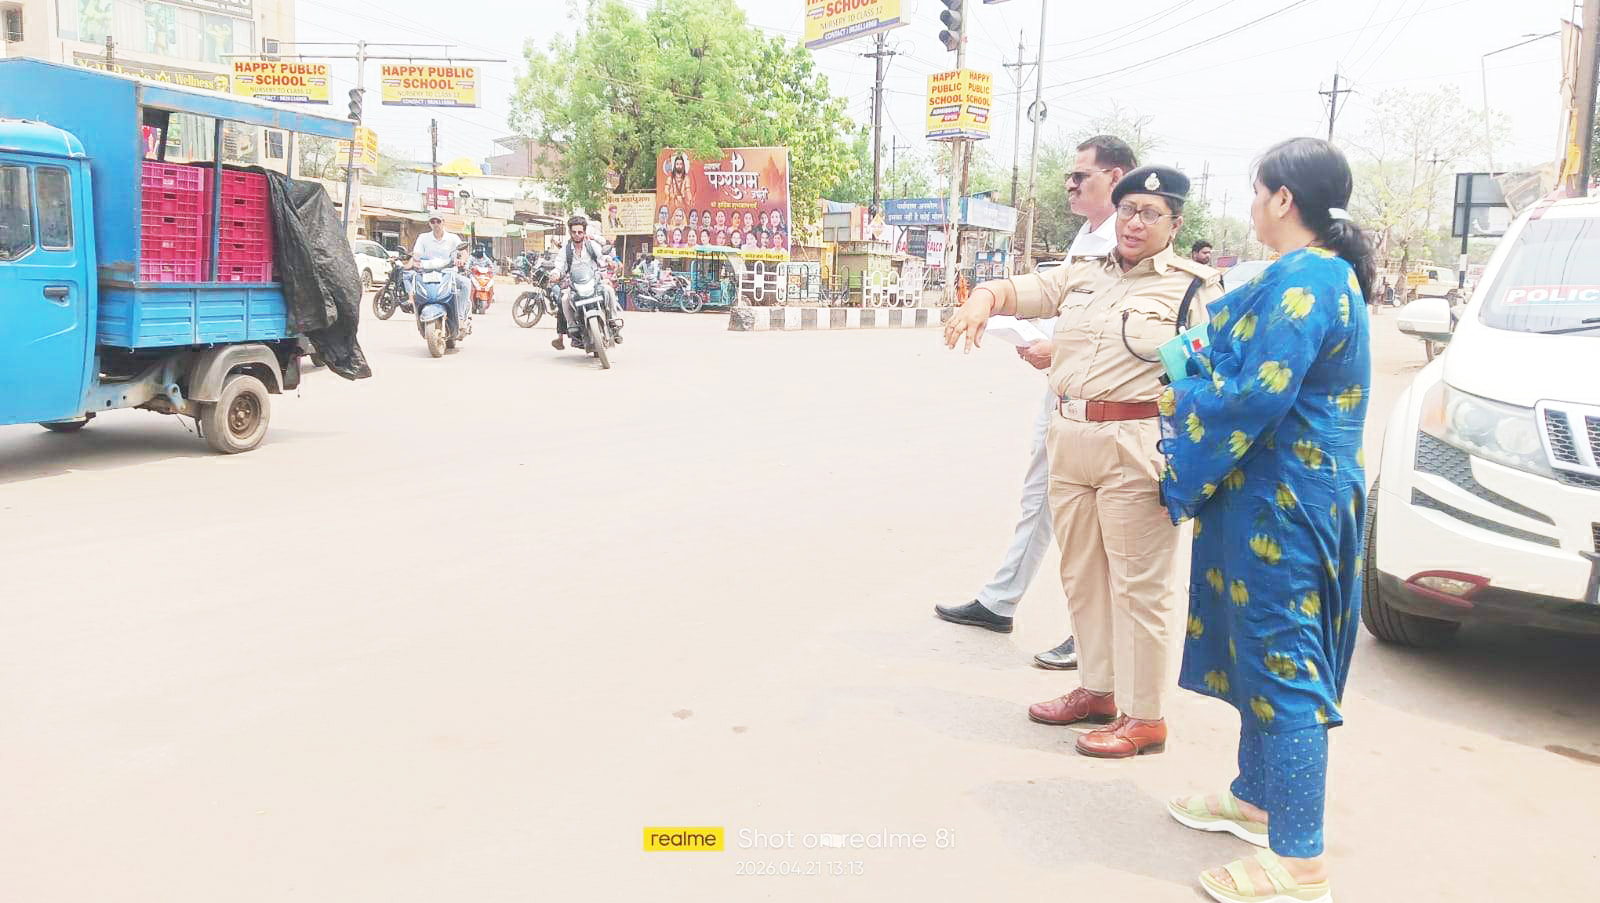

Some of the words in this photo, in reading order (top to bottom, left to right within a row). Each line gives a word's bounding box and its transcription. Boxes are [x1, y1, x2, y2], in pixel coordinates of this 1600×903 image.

[820, 16, 847, 29] NURSERY
[848, 14, 856, 22] TO
[857, 8, 874, 20] CLASS
[235, 62, 277, 73] HAPPY
[280, 63, 326, 75] PUBLIC
[382, 65, 424, 77] HAPPY
[428, 67, 474, 78] PUBLIC
[175, 73, 214, 90] Wellness
[255, 75, 307, 87] SCHOOL
[932, 71, 961, 82] HAPPY
[969, 71, 990, 83] HAPPY
[403, 78, 454, 90] SCHOOL
[931, 82, 962, 94] PUBLIC
[968, 82, 990, 94] PUBLIC
[929, 94, 963, 106] SCHOOL
[966, 94, 990, 106] SCHOOL
